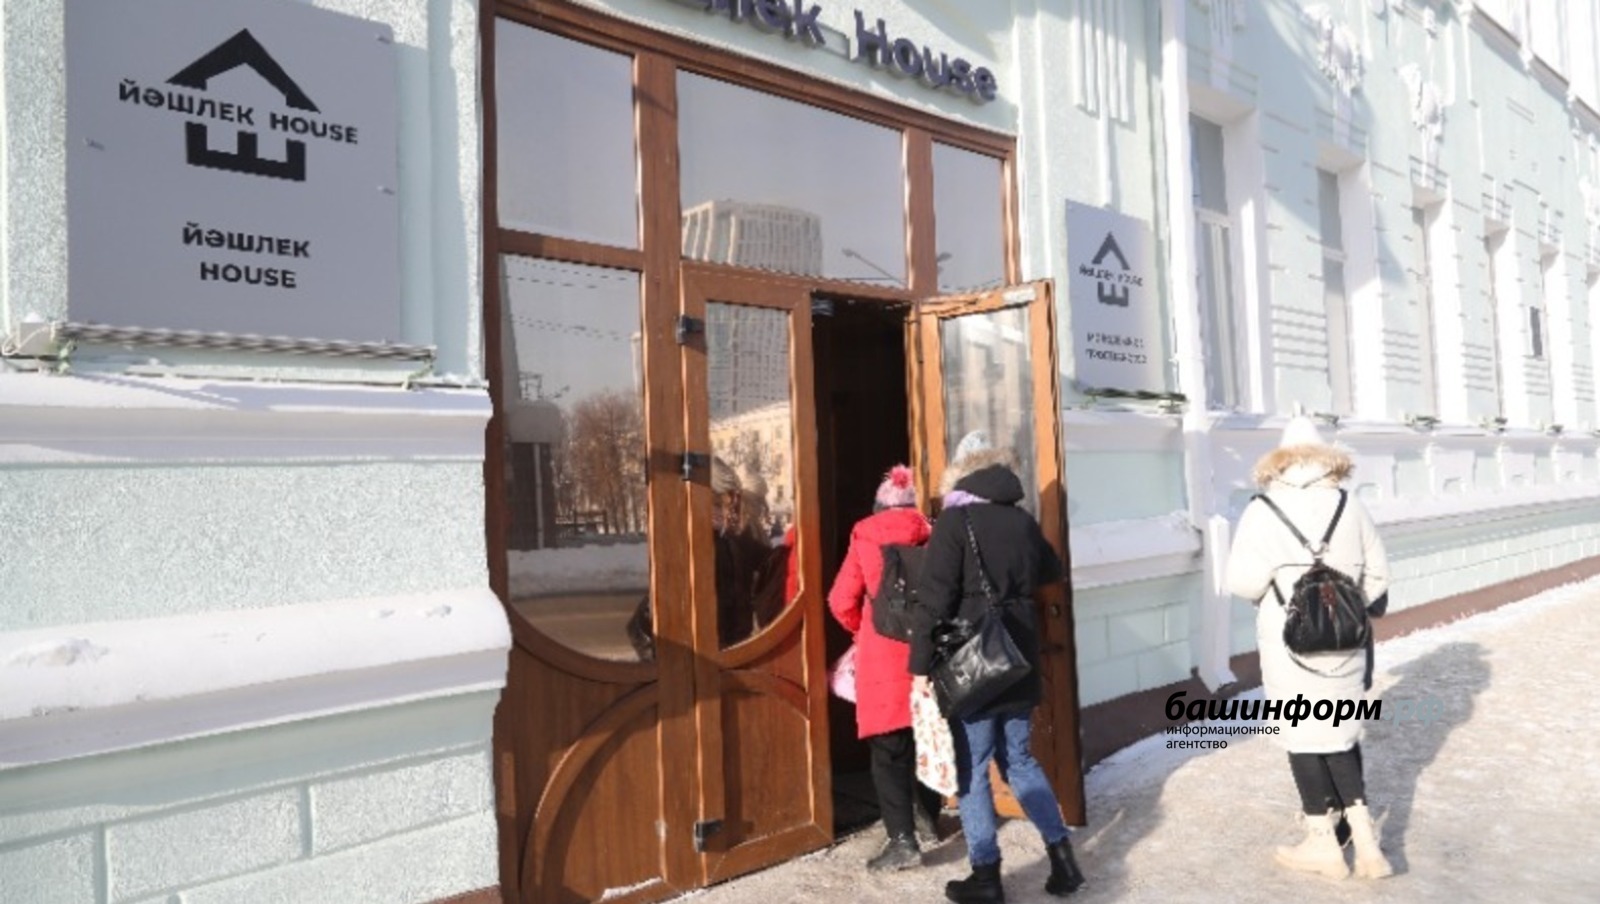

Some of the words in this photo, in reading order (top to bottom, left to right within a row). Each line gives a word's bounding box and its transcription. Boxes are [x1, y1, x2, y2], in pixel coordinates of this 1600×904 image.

[853, 10, 998, 105] House
[269, 113, 359, 145] HOUSE
[200, 262, 298, 289] HOUSE
